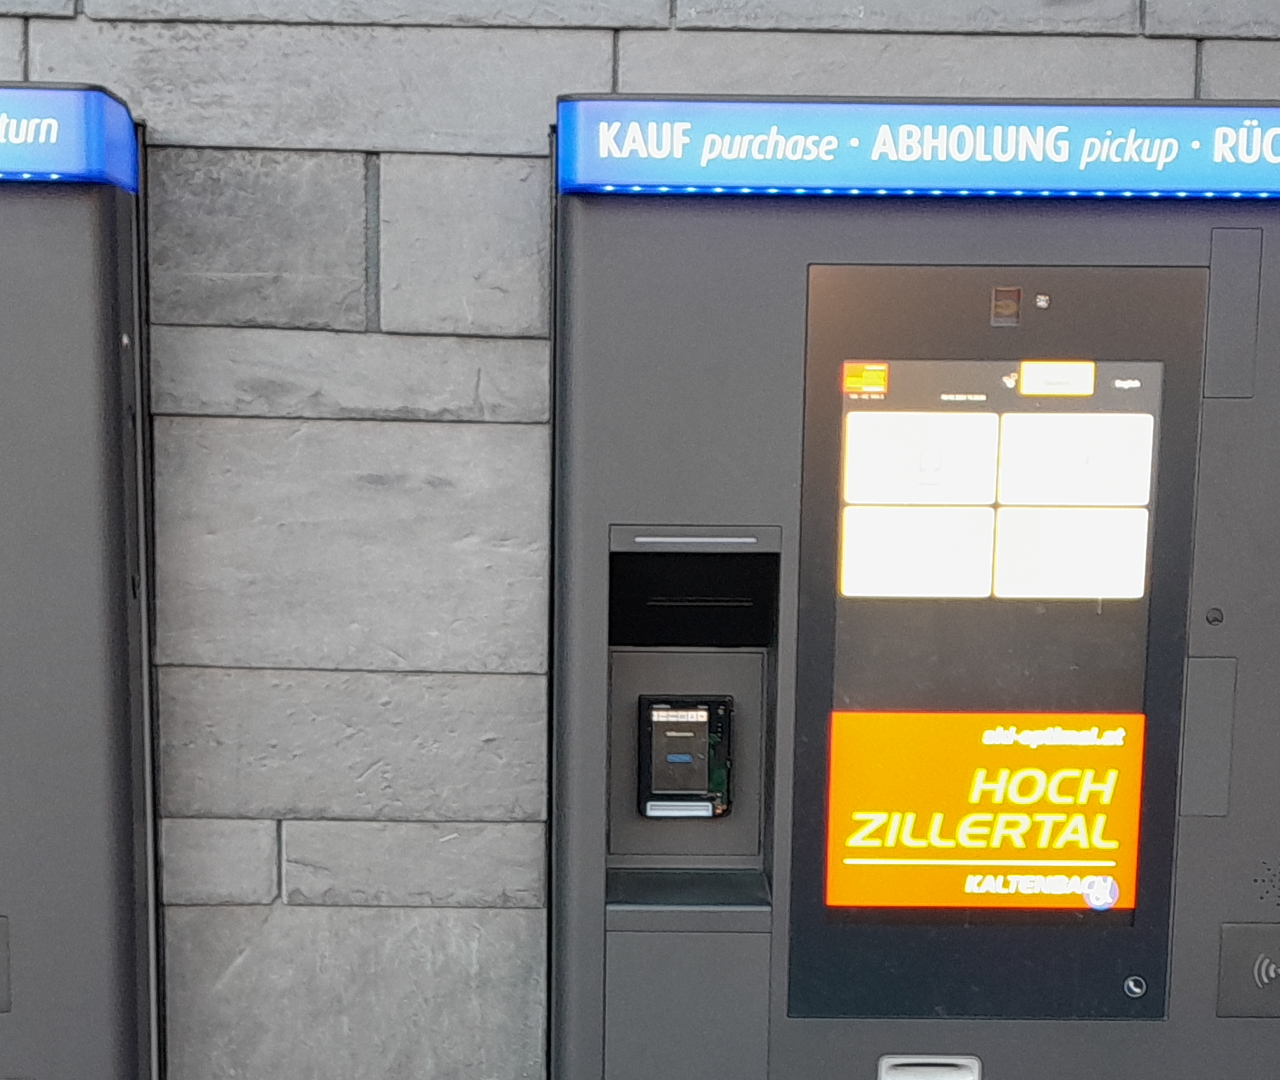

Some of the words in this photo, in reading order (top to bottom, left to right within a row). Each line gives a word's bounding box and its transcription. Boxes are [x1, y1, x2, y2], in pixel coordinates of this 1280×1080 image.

[599, 122, 691, 159] KAUF
[700, 126, 838, 167] purchase
[871, 124, 1069, 162] ABHOLUNG
[1080, 130, 1179, 170] pickup
[969, 768, 1118, 805] HOCH
[846, 812, 1119, 849] ZILLERTAL
